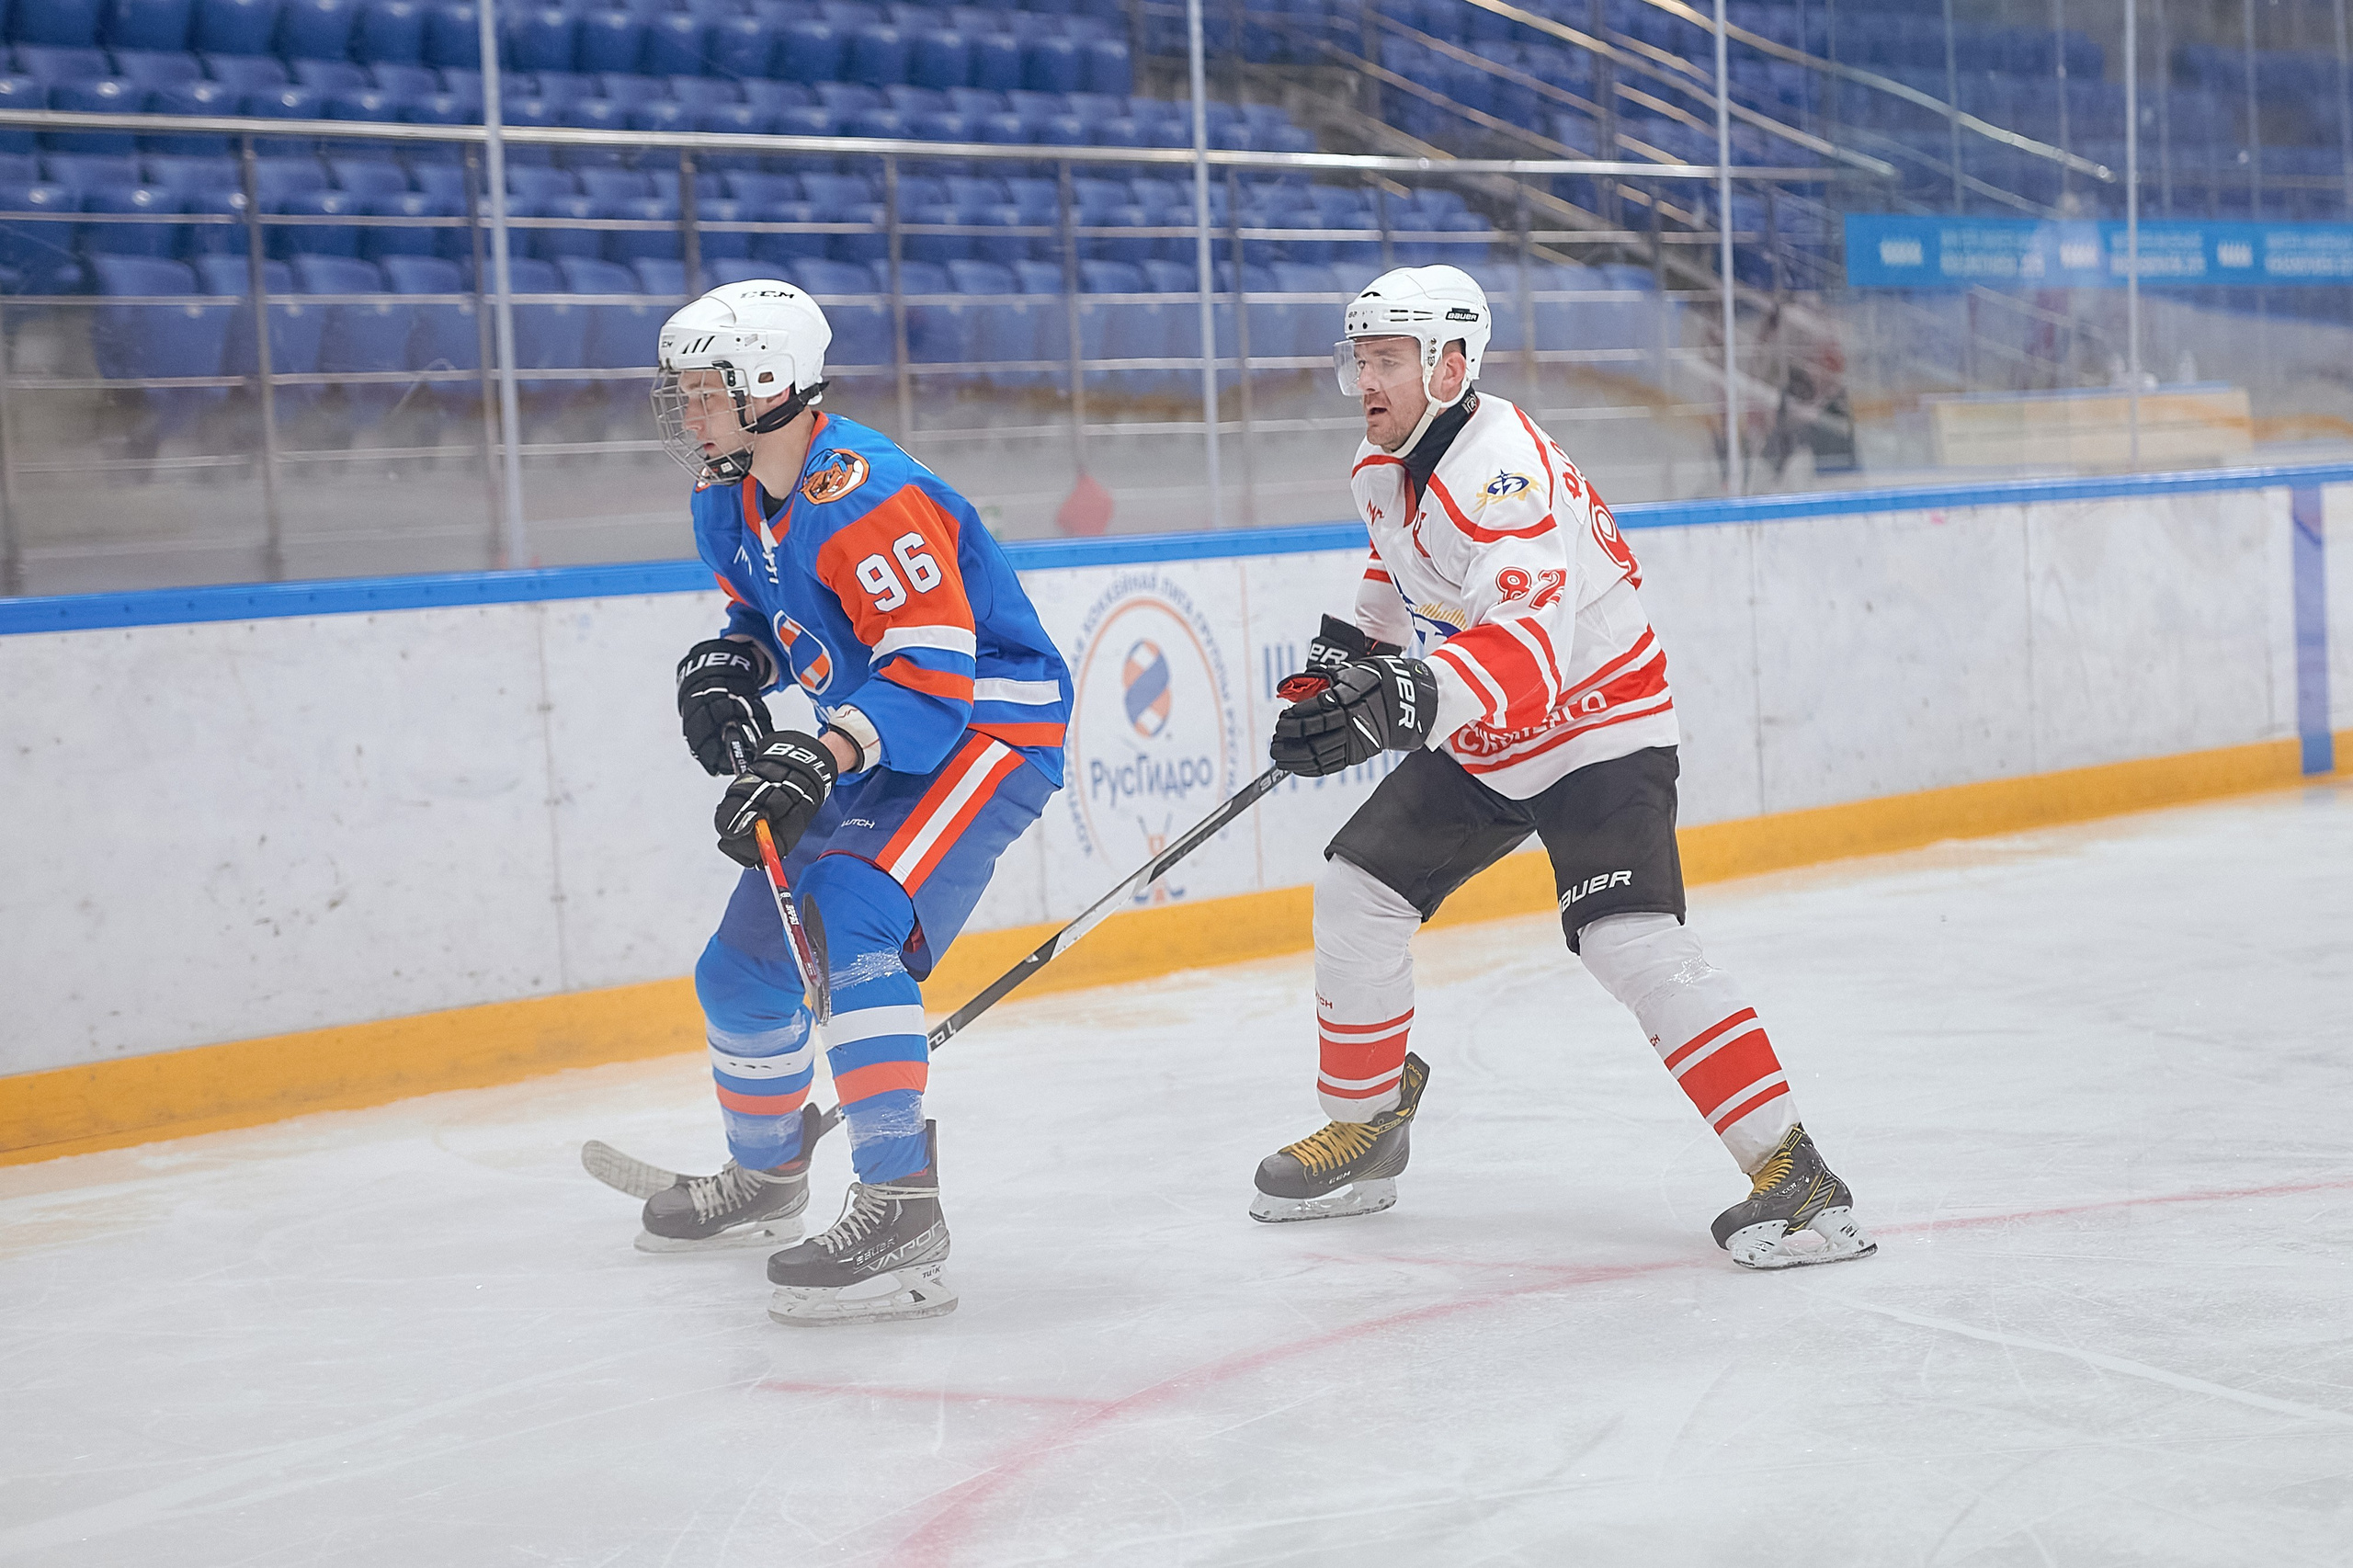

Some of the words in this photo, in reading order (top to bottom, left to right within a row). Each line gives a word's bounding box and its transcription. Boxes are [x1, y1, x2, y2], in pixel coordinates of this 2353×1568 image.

[740, 290, 795, 299] CCM
[1447, 312, 1478, 321] BAUER
[856, 531, 943, 613] 96
[1495, 565, 1567, 611] 82
[676, 652, 751, 687] AUER
[1090, 753, 1213, 809] РусГидро
[1558, 869, 1632, 918] AUER
